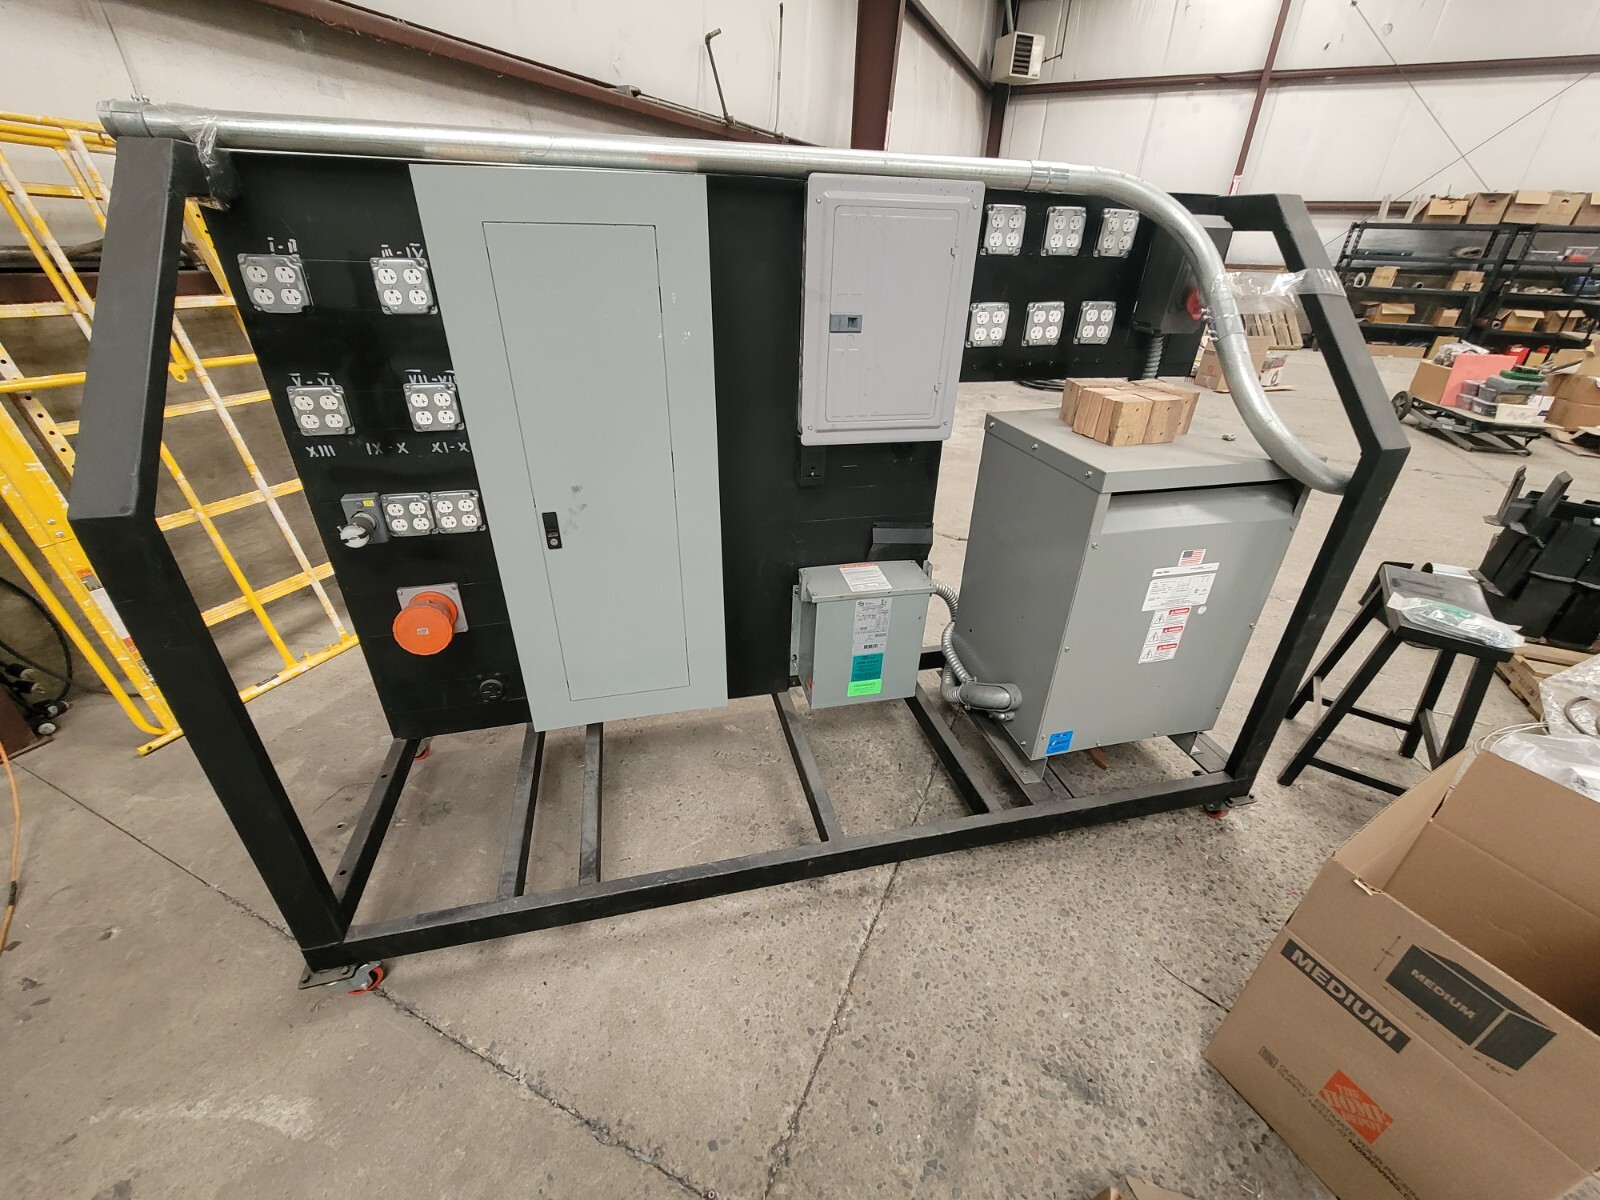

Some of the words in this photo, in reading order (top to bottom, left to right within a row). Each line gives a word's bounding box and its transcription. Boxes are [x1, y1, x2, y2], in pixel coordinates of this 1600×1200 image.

[305, 444, 337, 458] XIII
[1291, 949, 1398, 1043] MEDIUM
[1410, 968, 1477, 1020] MEDIUM
[1276, 1068, 1308, 1098] SUPPLY
[1307, 1098, 1335, 1128] NEEDS
[1280, 1064, 1314, 1097] QUICKLY
[1315, 1098, 1356, 1139] ESTIMATE
[1357, 1138, 1384, 1166] YOUR
[1322, 1088, 1388, 1124] HOME
